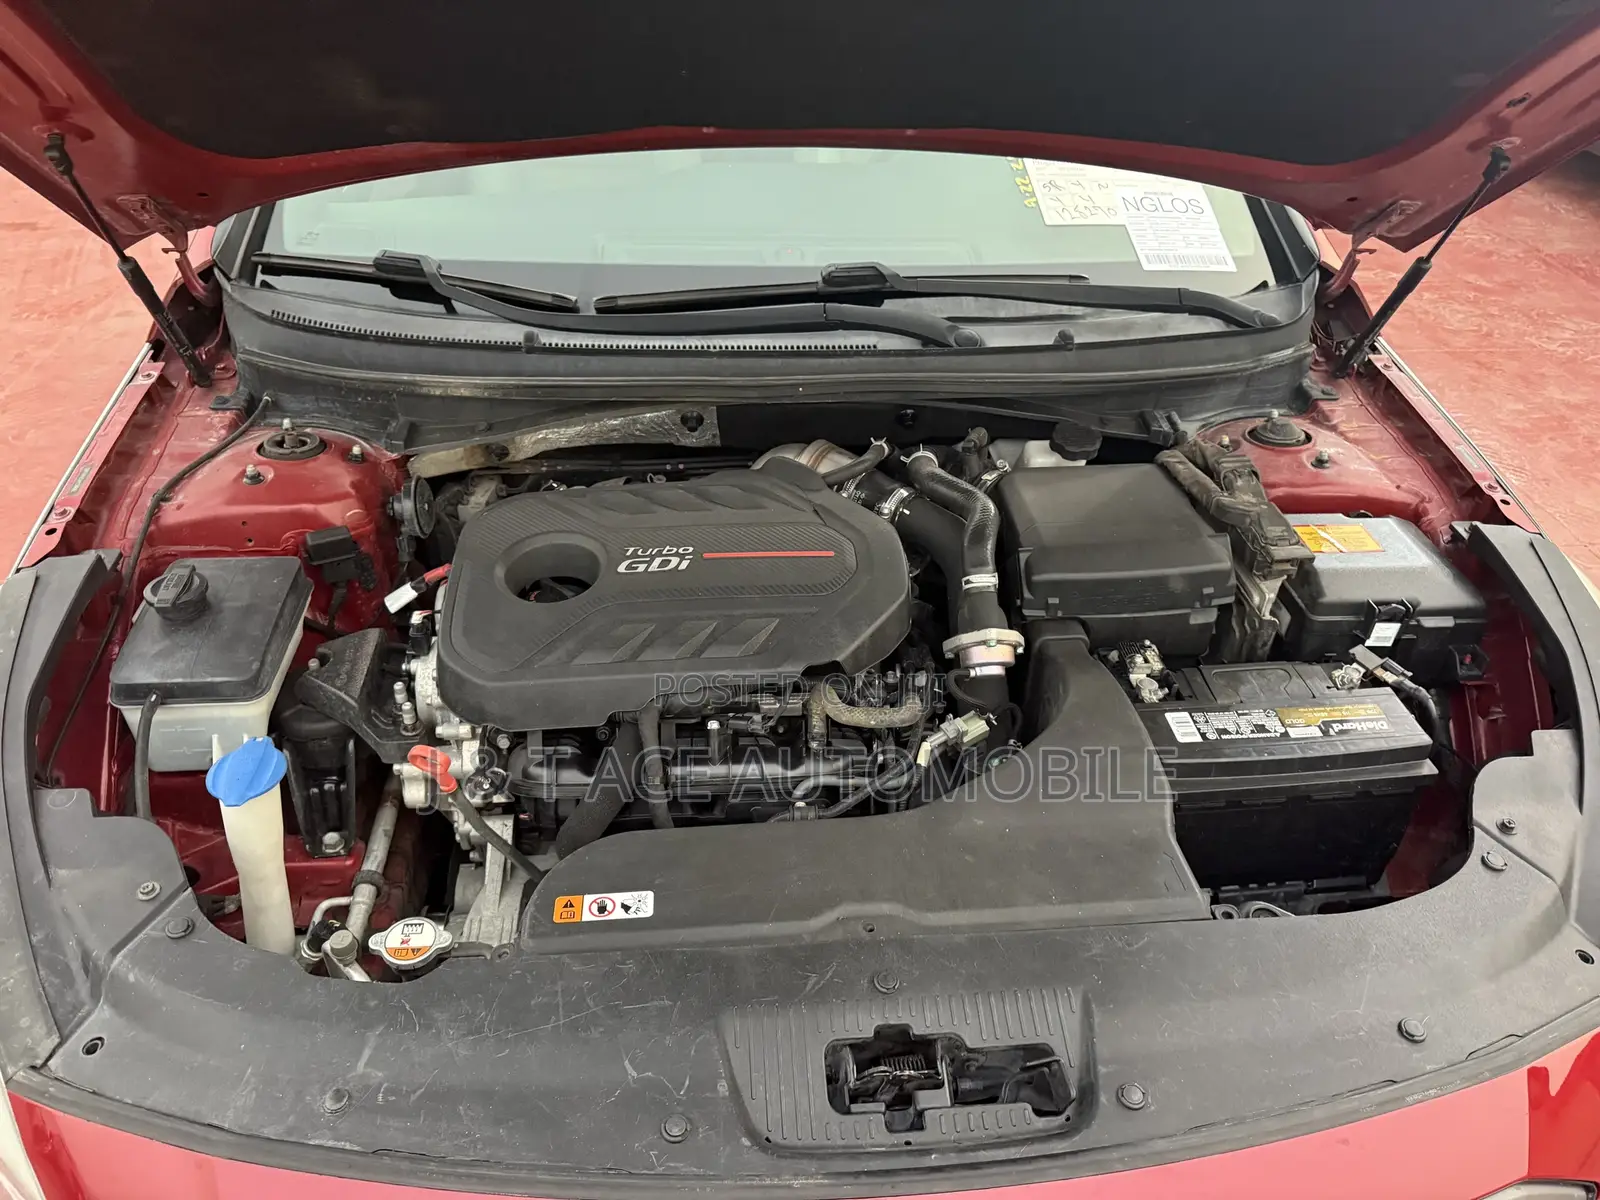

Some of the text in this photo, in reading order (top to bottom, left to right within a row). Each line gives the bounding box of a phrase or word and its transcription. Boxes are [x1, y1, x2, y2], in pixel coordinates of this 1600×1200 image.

[1121, 196, 1205, 214] NGLOS
[624, 545, 694, 556] Turbo
[616, 555, 694, 573] GDi
[1331, 718, 1390, 733] DieHard
